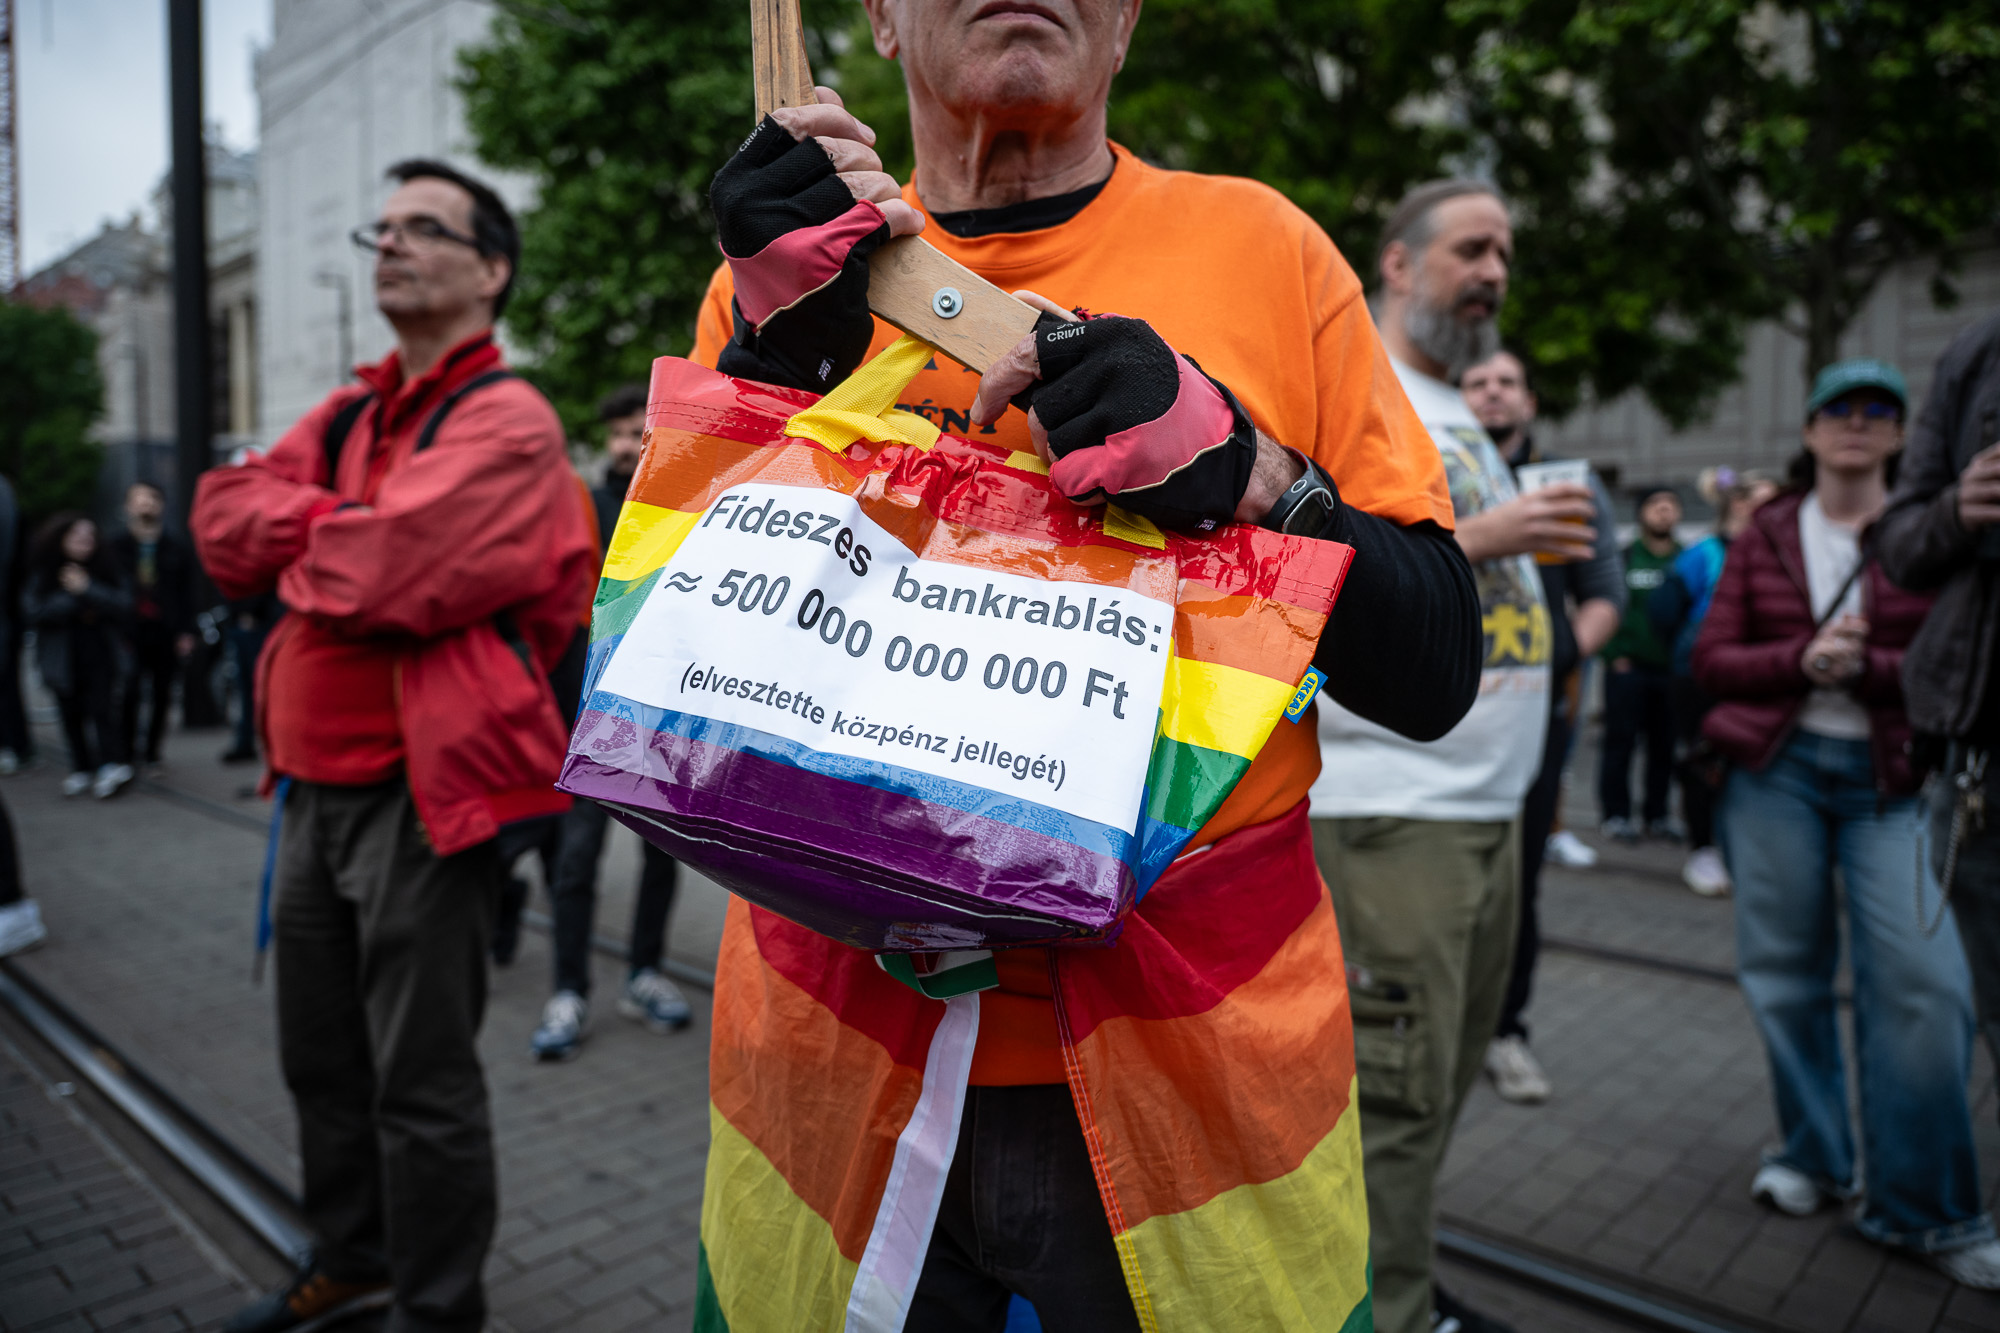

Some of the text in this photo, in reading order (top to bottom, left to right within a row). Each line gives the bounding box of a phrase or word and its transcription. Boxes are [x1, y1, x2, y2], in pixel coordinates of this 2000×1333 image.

[739, 121, 766, 152] CRIVIT
[1047, 325, 1086, 342] CRIVIT
[702, 495, 1163, 653] Fideszes bankrablás:
[711, 568, 791, 616] 500
[796, 588, 873, 658] 000
[884, 635, 969, 682] 000
[983, 653, 1068, 699] 000
[1082, 667, 1130, 720] Ft
[680, 661, 1067, 792] (elvesztette közpénz jellegét)
[1288, 676, 1317, 711] IKEA
